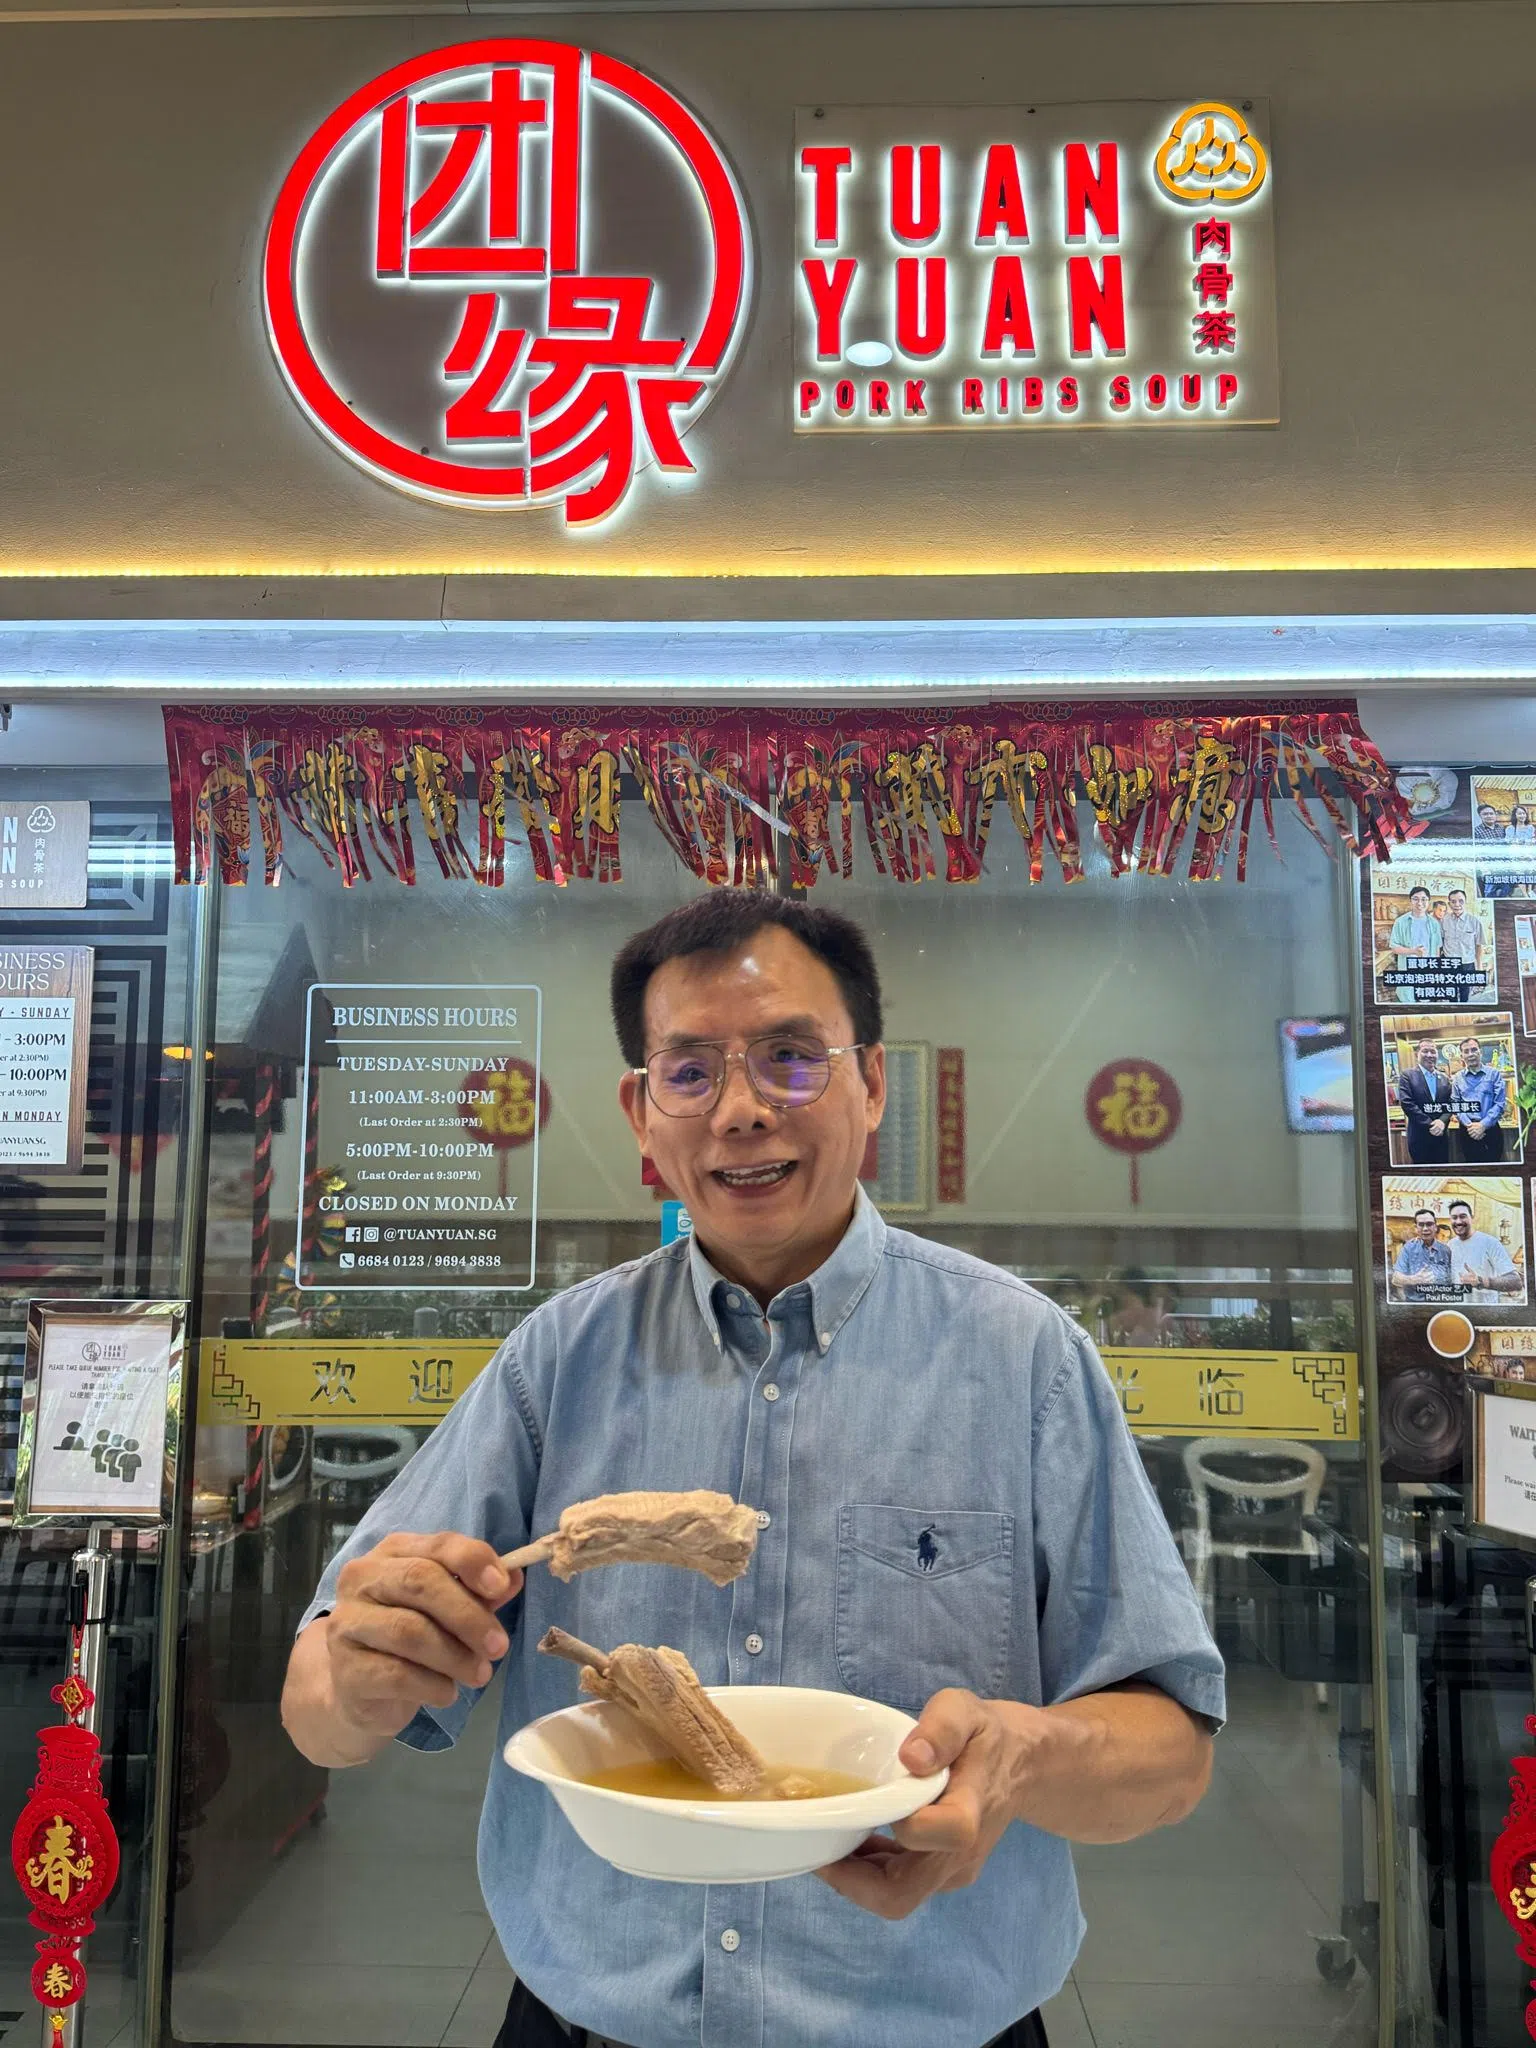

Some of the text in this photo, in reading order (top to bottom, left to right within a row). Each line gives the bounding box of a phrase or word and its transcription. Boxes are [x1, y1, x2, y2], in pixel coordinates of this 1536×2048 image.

[800, 143, 1120, 248] TUAN
[1193, 216, 1236, 355] 肉骨茶
[801, 255, 1127, 362] YUAN
[800, 374, 1238, 419] PORK RIBS SOUP
[11, 879, 44, 888] SOUP
[0, 952, 65, 970] INESS
[1415, 987, 1456, 997] 有限公司
[21, 1007, 70, 1018] SUNDAY
[332, 1007, 517, 1027] BUSINESS HOURS
[14, 1033, 66, 1045] 3:00PM
[337, 1057, 509, 1071] TUESDAY-SUNDAY
[10, 1068, 67, 1080] 10:00PM
[349, 1090, 496, 1104] 11:00AM-3:00PM
[15, 1111, 61, 1120] MONDAY
[359, 1116, 483, 1128] (Last Order at 2:30PM)
[346, 1143, 495, 1158] 5:00PM-10:00PM
[357, 1170, 481, 1181] (Last Order at 9:30PM)
[318, 1196, 518, 1211] CLOSED ON MONDAY
[383, 1228, 497, 1242] @TUANYUAN.SG
[357, 1255, 390, 1267] 6684
[393, 1255, 424, 1267] 0123
[434, 1255, 466, 1267] 9694
[470, 1255, 501, 1267] 3838
[26, 1815, 94, 1904] 春
[43, 1963, 73, 1998] 春
